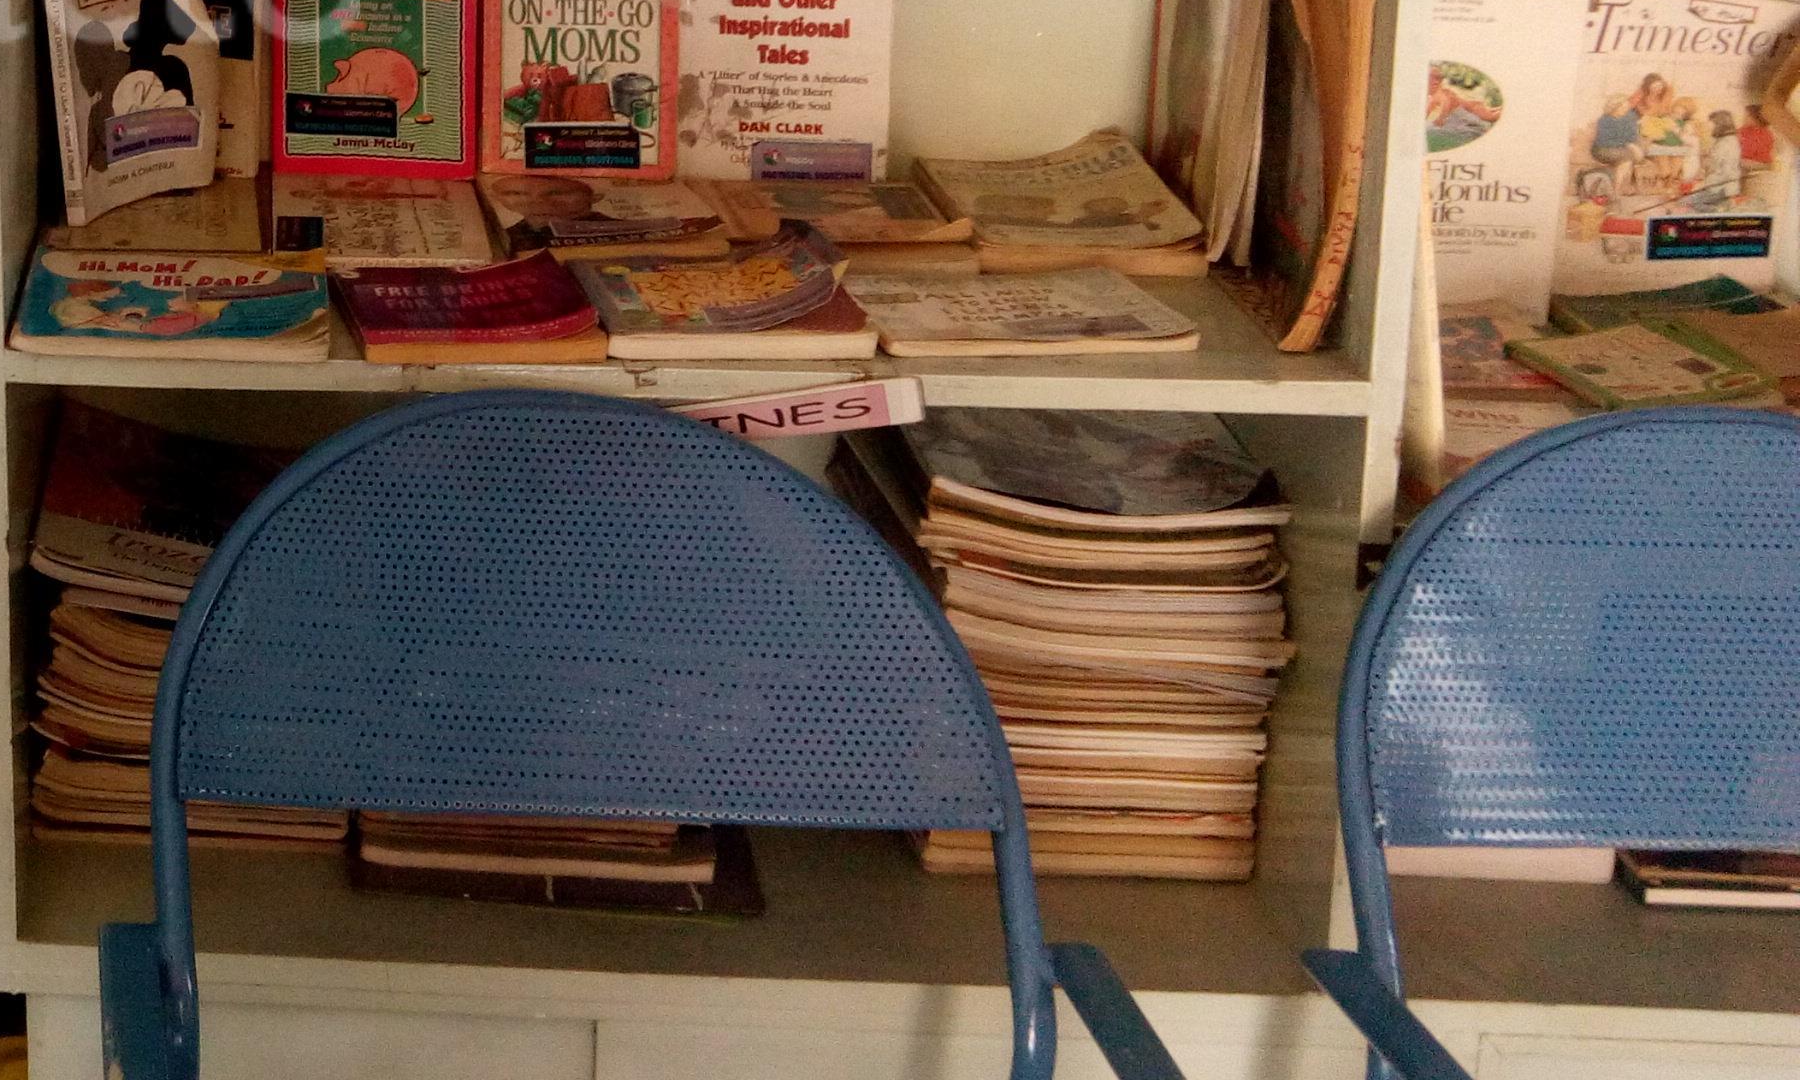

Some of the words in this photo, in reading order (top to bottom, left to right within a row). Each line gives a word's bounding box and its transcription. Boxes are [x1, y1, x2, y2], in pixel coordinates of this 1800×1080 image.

[718, 15, 852, 39] Inspirational
[522, 26, 641, 68] MOMS
[758, 44, 809, 65] Tales
[750, 71, 761, 81] of
[763, 72, 798, 83] Stories
[815, 73, 869, 84] Anecdotes
[732, 85, 756, 94] That
[782, 85, 800, 96] the
[803, 87, 833, 97] Heart
[787, 100, 805, 109] the
[808, 101, 832, 110] Soul
[739, 121, 770, 133] DAN
[776, 123, 824, 135] CLARK
[1432, 200, 1464, 223] ife
[374, 285, 429, 297] FREE
